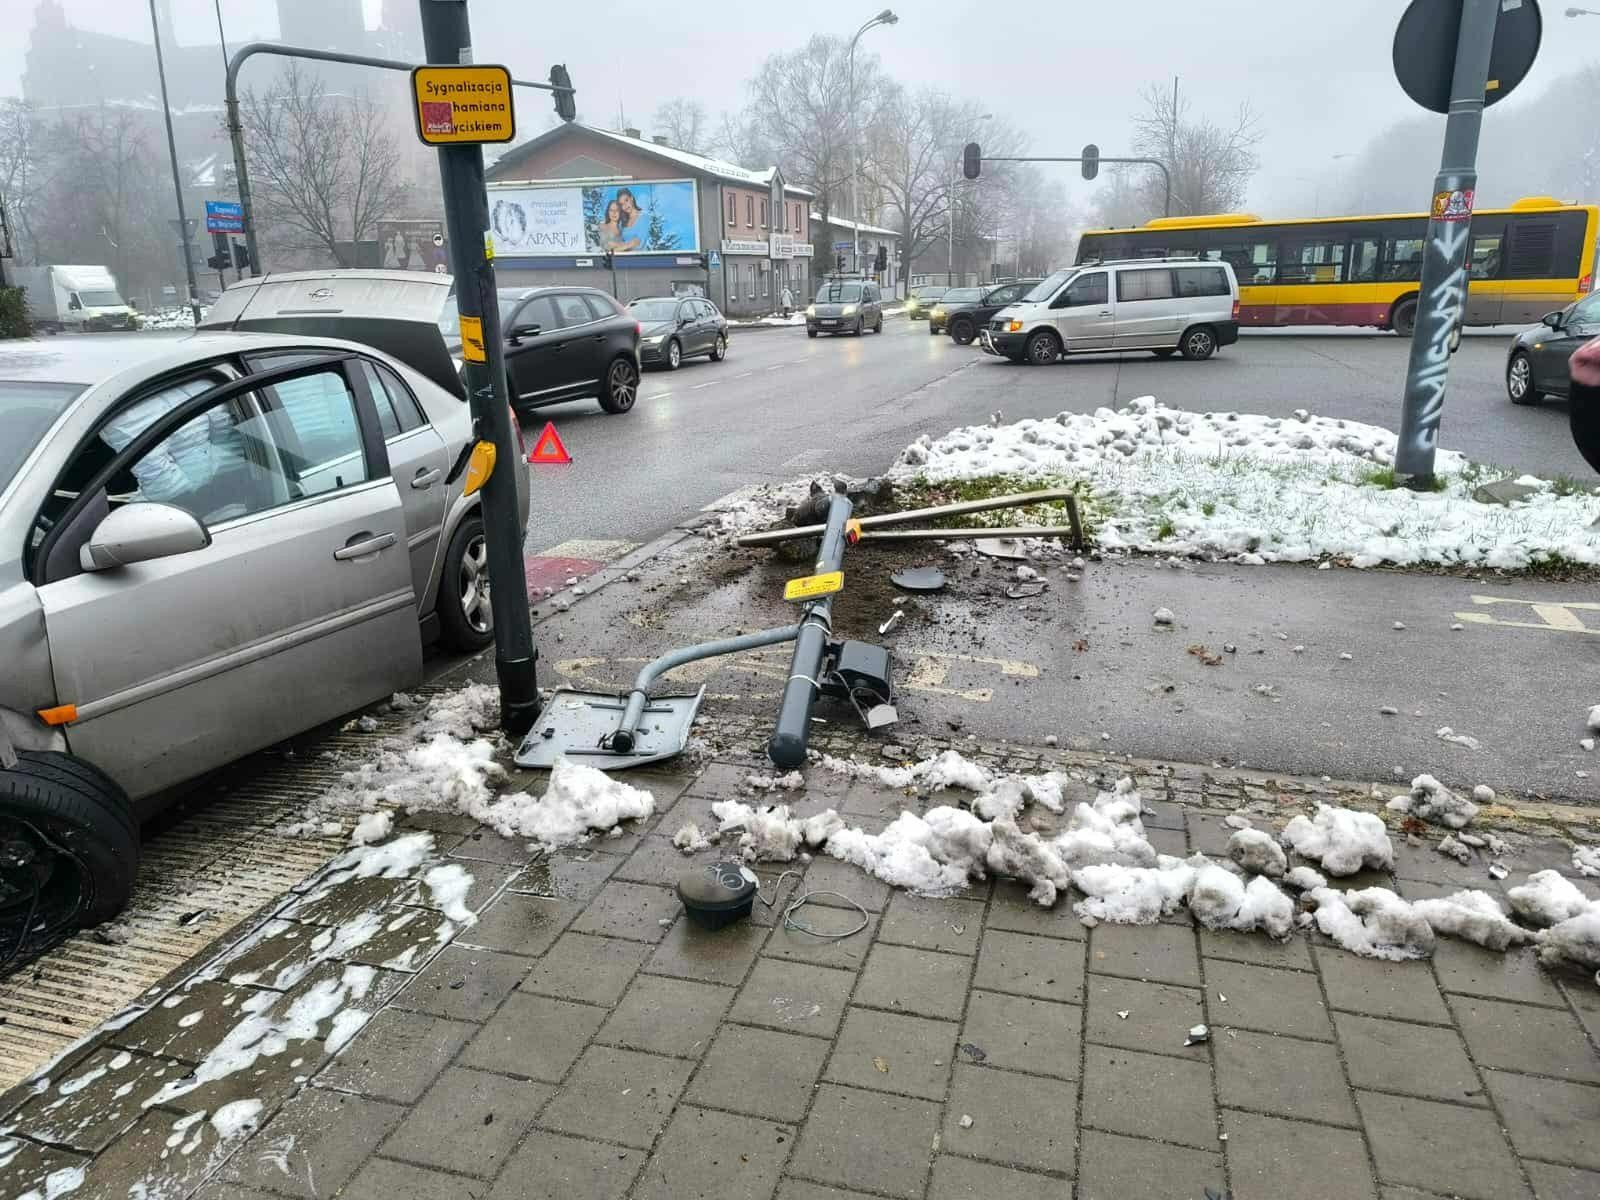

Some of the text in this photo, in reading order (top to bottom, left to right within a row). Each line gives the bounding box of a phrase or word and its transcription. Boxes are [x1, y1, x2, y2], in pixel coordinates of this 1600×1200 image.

[425, 80, 502, 96] Sygnalizacja
[453, 101, 505, 113] hamiana
[452, 120, 502, 135] yciskiem
